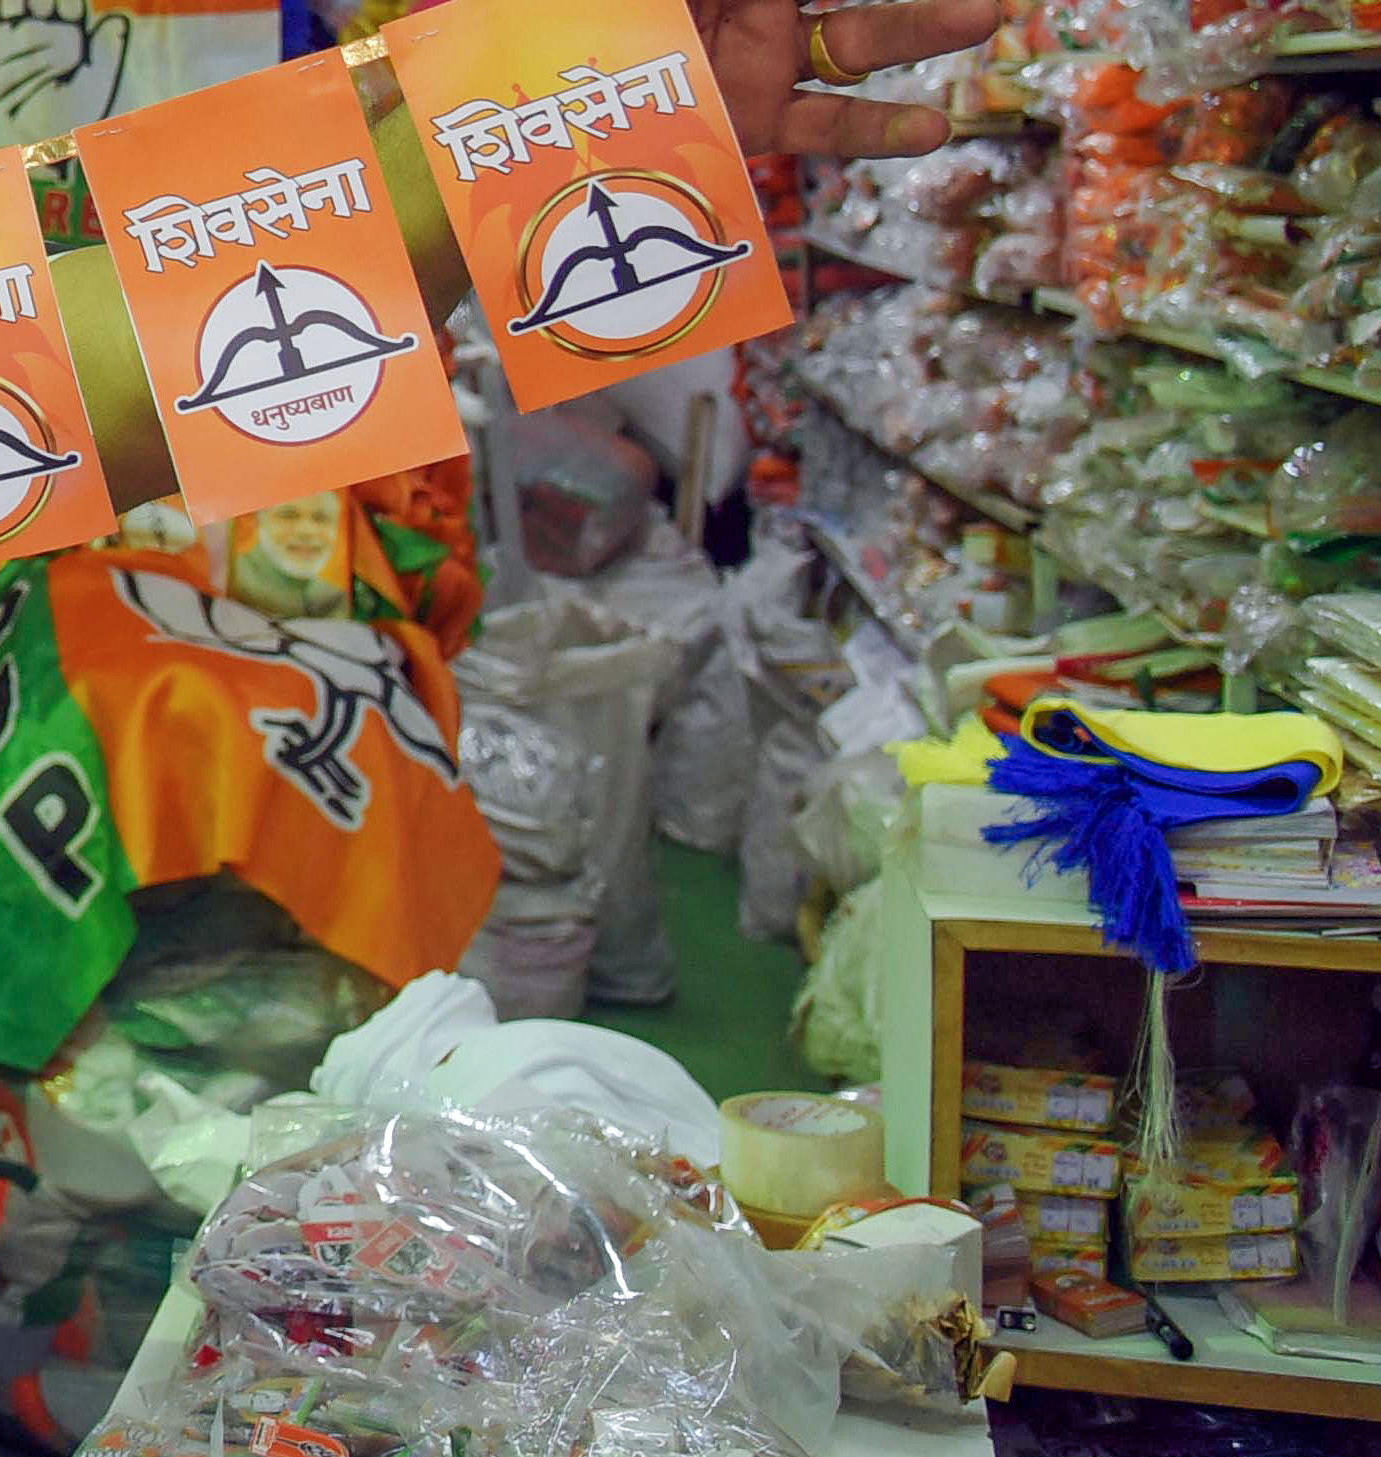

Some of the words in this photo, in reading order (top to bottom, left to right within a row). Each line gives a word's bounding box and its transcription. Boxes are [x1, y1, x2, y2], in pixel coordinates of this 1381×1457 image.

[432, 52, 699, 183] शिवसेना
[125, 157, 373, 274] शिवसेना
[251, 386, 355, 432] धनुष्यबाण
